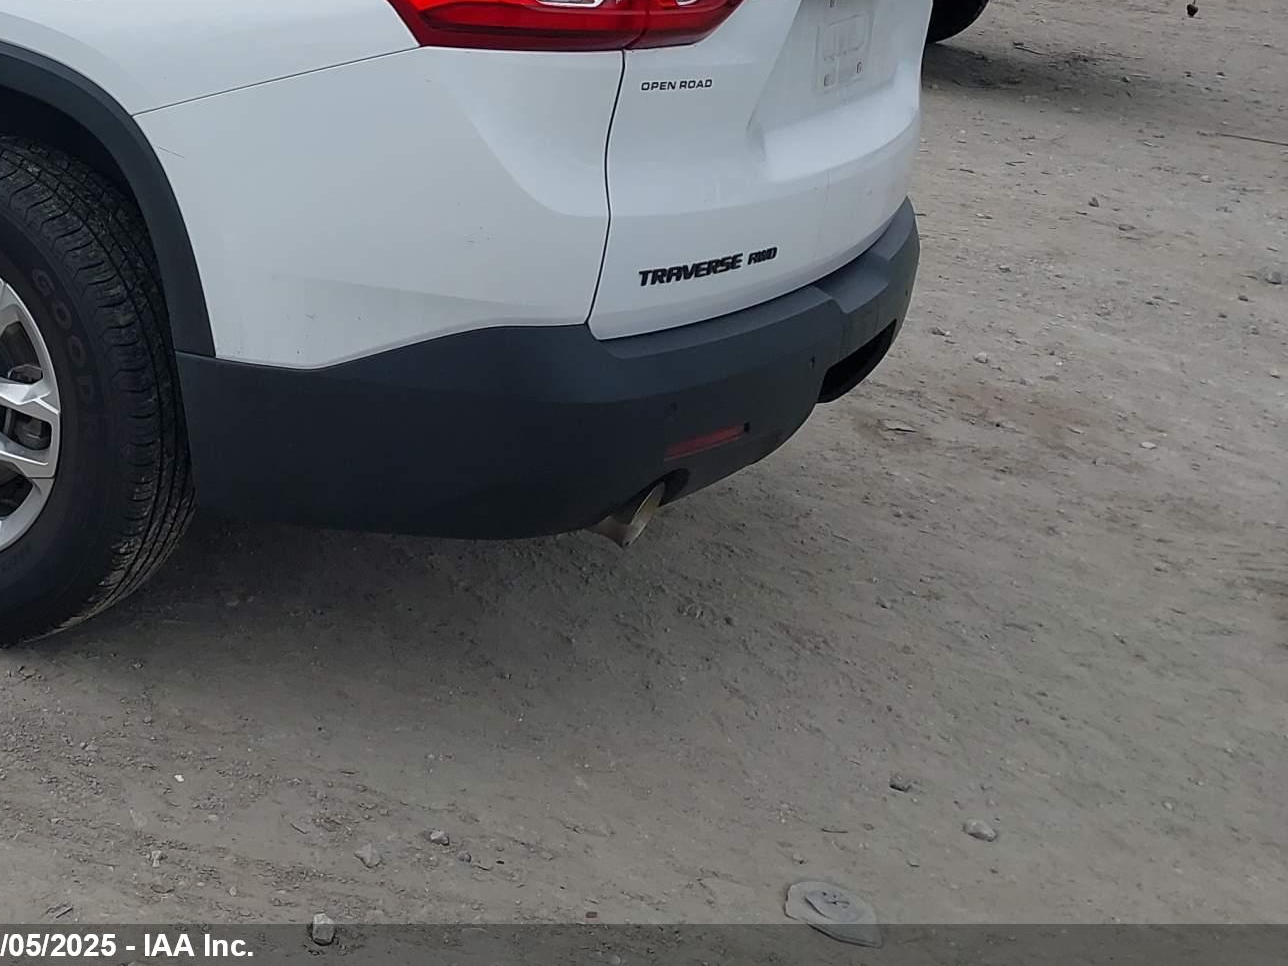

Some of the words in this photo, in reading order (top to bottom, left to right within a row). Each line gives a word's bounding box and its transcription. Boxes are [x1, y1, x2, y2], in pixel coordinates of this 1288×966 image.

[640, 81, 677, 92] OPEN
[679, 78, 713, 90] ROAD
[638, 253, 743, 287] TRAVERSE
[747, 246, 778, 266] AWD
